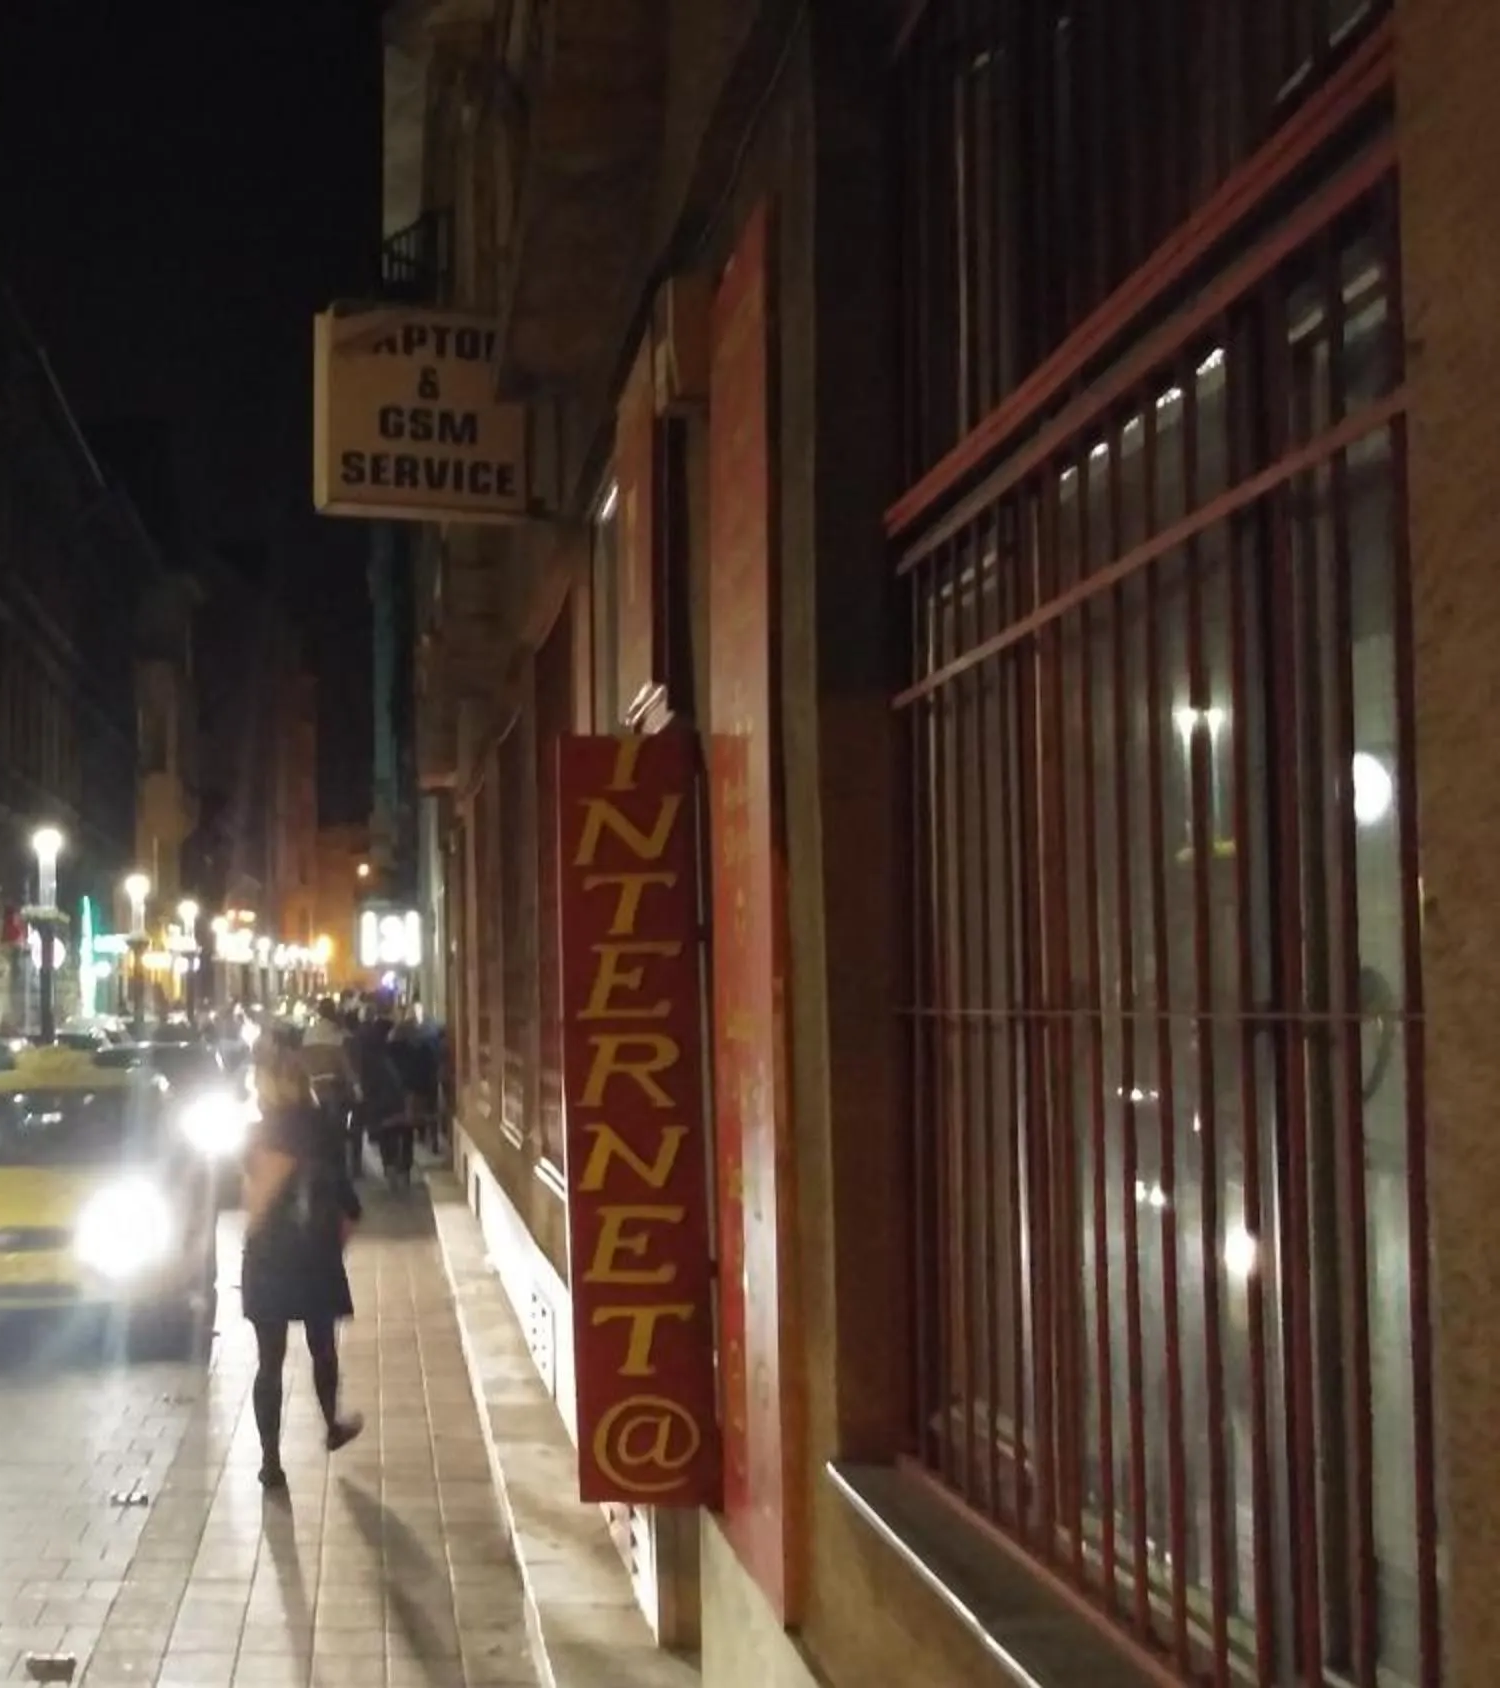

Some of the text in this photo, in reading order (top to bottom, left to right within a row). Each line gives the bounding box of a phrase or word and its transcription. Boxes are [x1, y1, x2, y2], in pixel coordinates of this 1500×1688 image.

[417, 365, 440, 401] &
[378, 405, 478, 446] GSM
[340, 451, 517, 498] SERVICE
